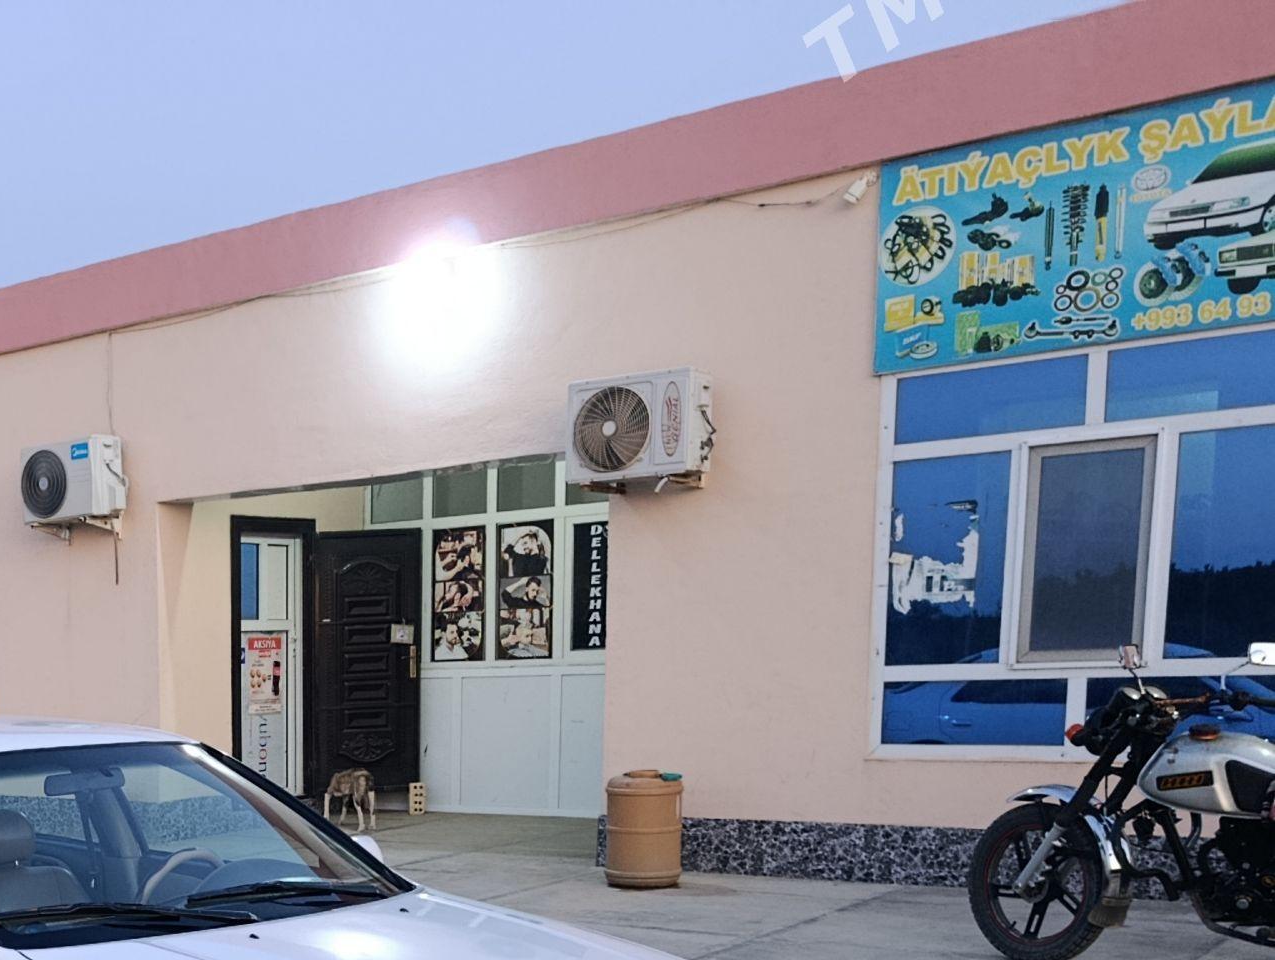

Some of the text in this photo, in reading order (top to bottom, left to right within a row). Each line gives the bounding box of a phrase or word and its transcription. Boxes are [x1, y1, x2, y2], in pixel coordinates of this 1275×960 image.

[1131, 291, 1271, 331] +993 64 93
[588, 524, 603, 647] DELLEKHANA
